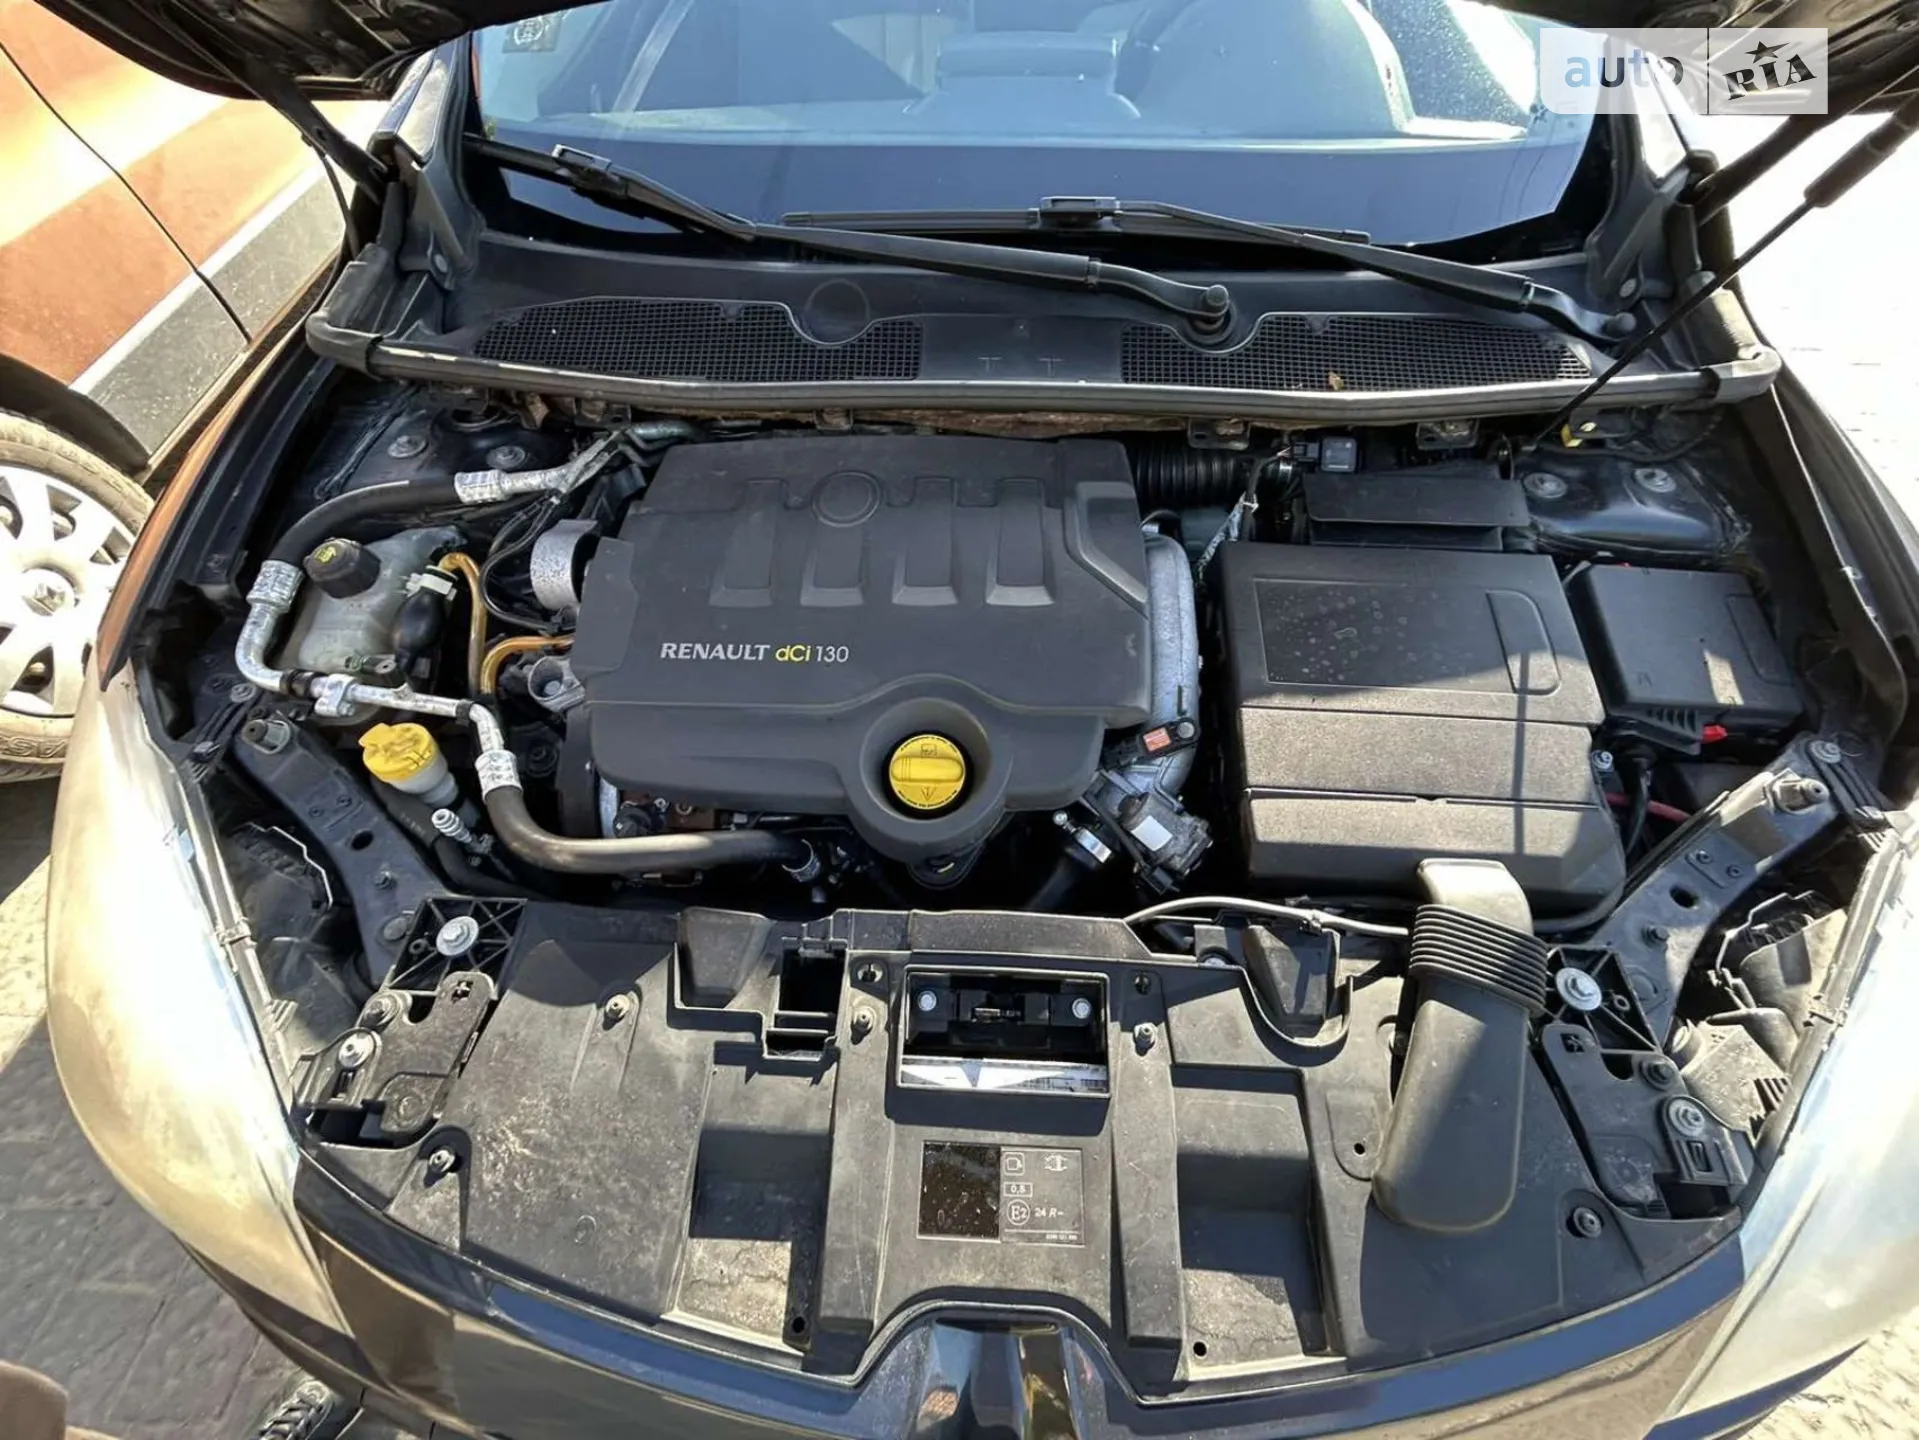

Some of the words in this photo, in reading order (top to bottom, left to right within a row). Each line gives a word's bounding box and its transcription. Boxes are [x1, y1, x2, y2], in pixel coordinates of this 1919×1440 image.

[660, 642, 770, 661] RENAULT
[775, 644, 811, 662] dCi
[815, 645, 849, 663] 130
